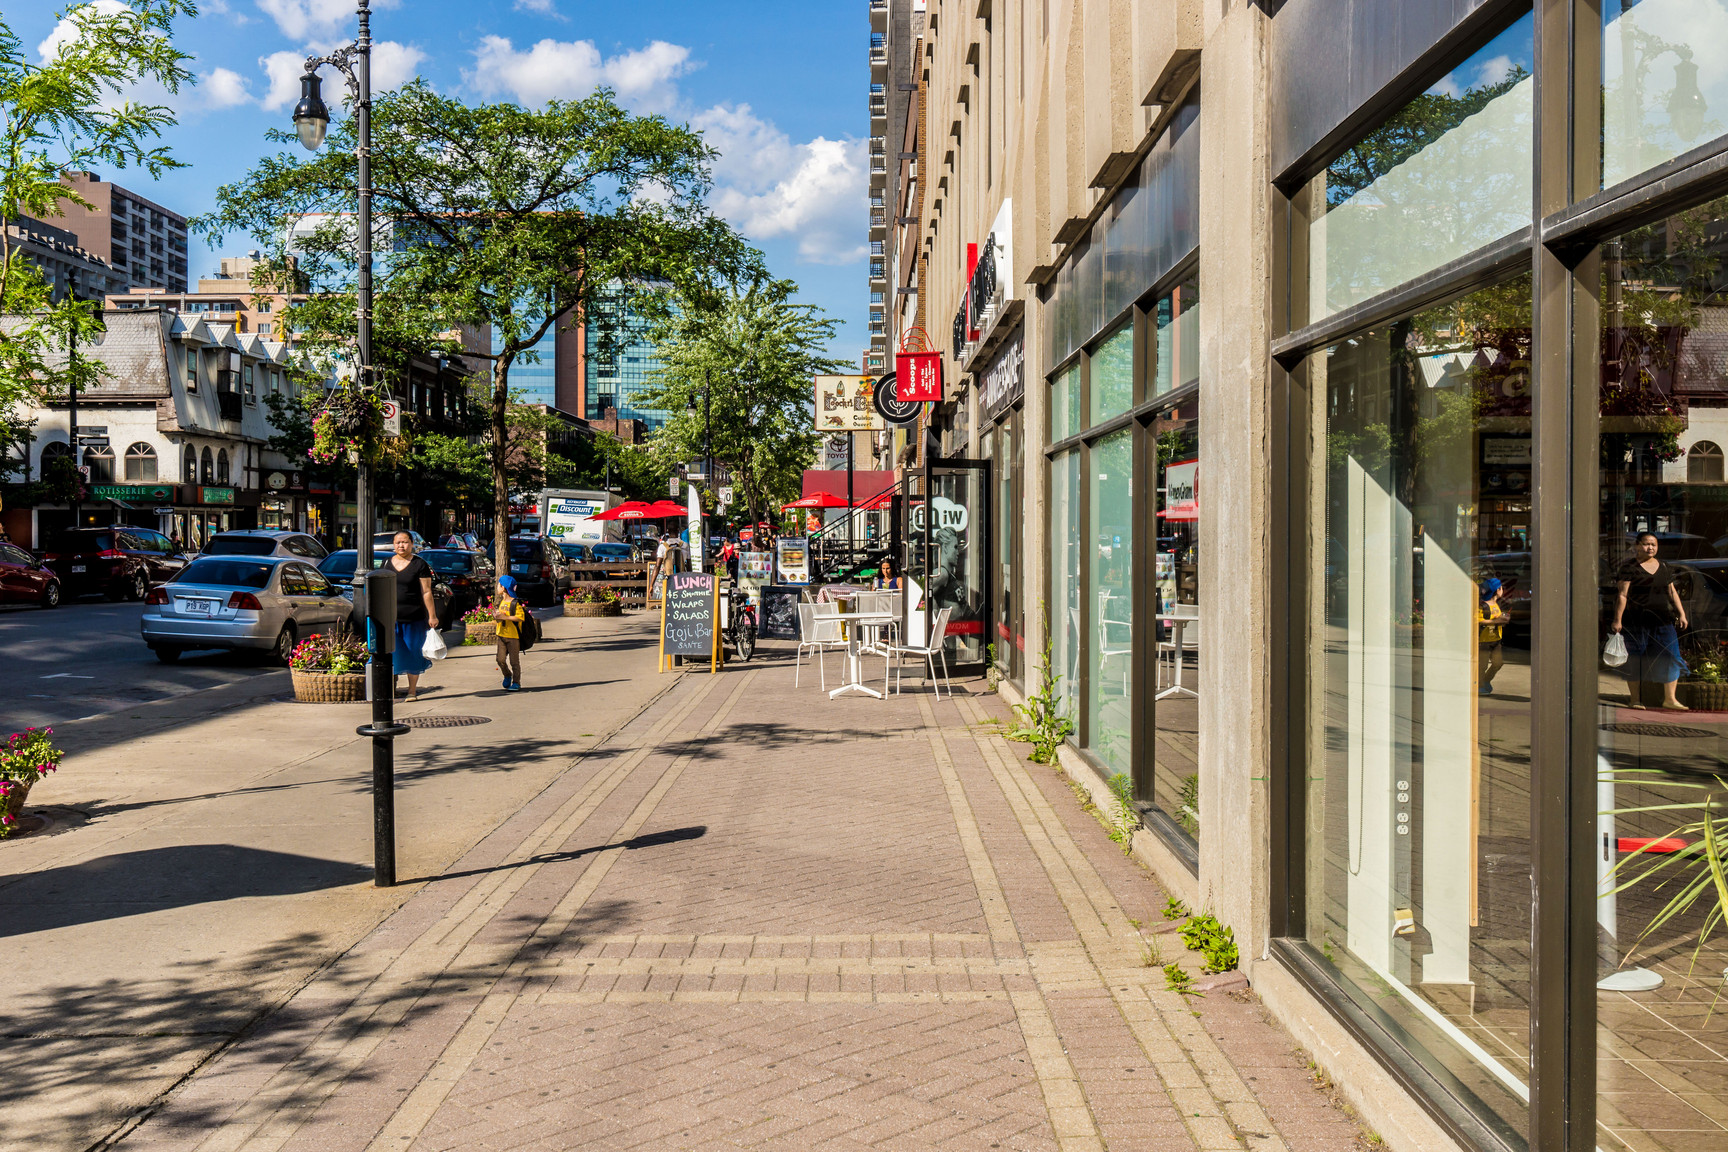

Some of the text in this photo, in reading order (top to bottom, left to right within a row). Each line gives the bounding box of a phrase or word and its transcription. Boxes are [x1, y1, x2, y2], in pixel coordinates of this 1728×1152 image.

[909, 358, 917, 395] Scoops
[93, 486, 146, 495] RÔTISSERIE
[559, 505, 591, 514] Discount
[673, 575, 713, 592] LUNCH
[666, 589, 679, 599] $5
[665, 622, 713, 642] Goji Bar
